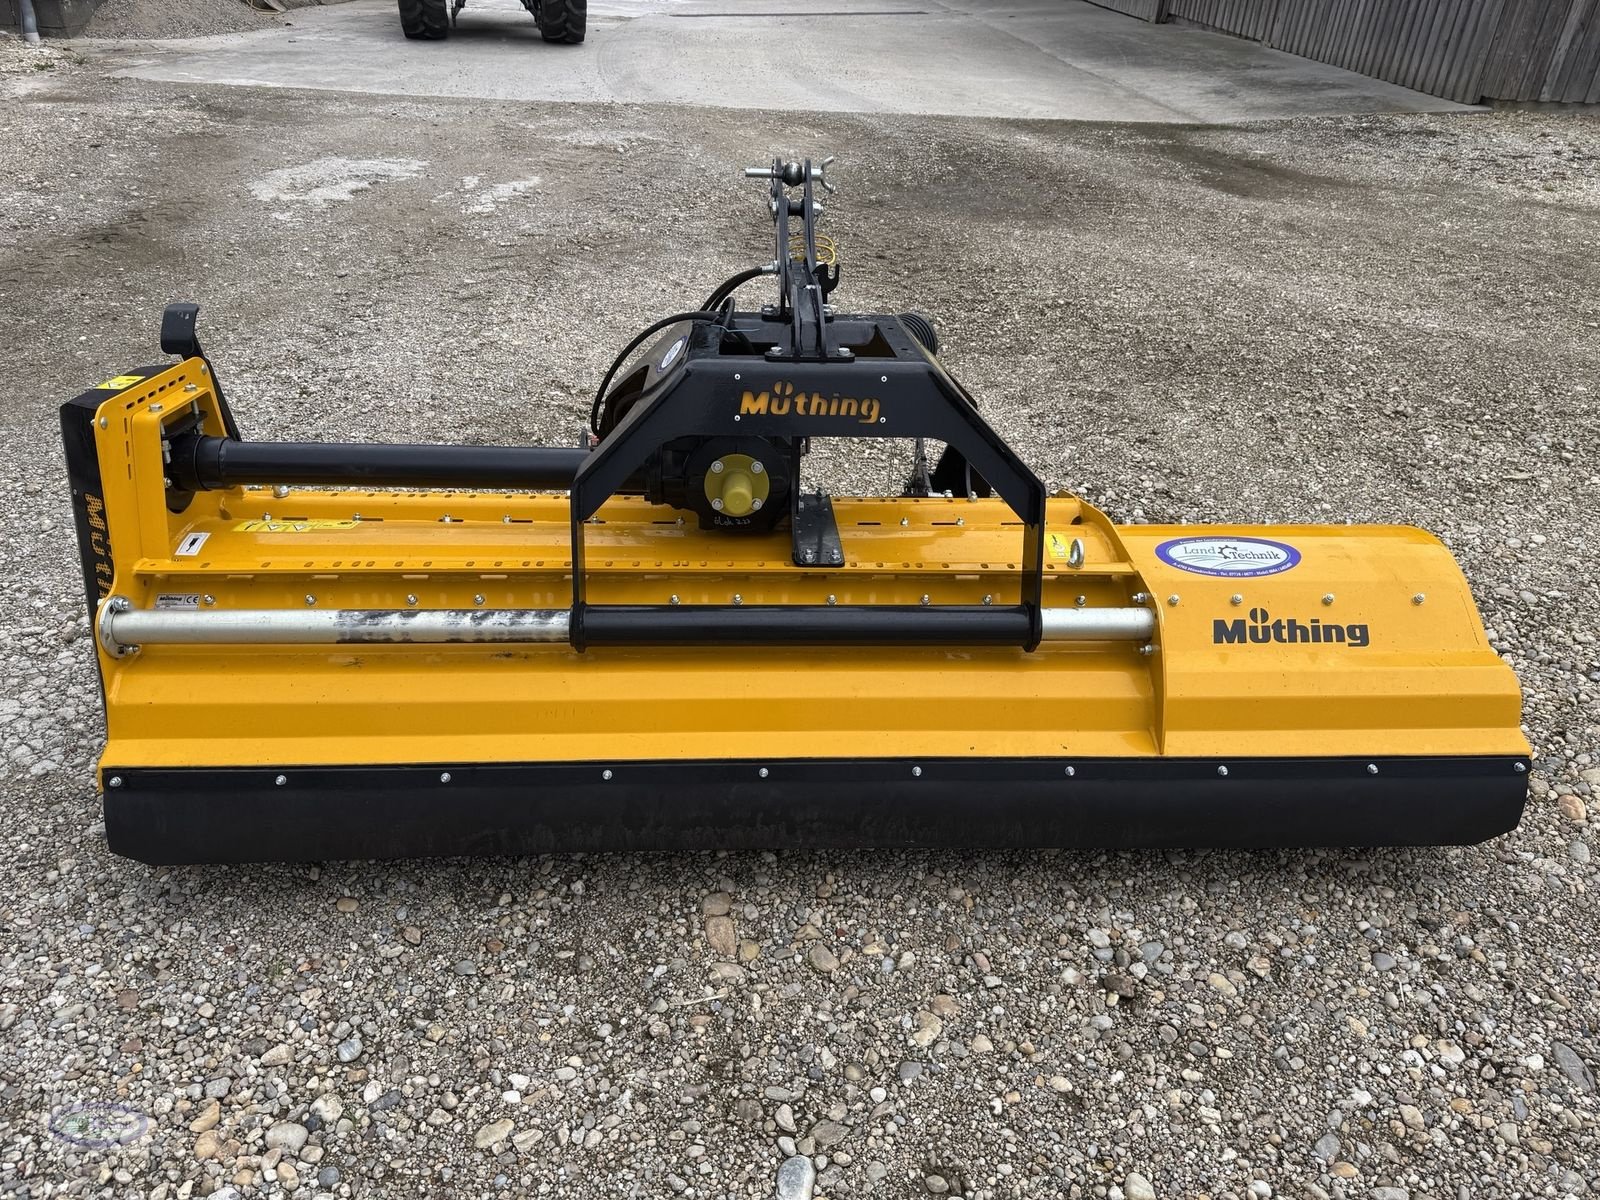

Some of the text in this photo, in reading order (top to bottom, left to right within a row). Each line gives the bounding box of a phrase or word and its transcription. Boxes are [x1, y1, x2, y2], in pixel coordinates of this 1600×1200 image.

[740, 381, 880, 423] Müthing
[1184, 546, 1281, 560] Land Technik
[1213, 608, 1370, 647] Müthing
